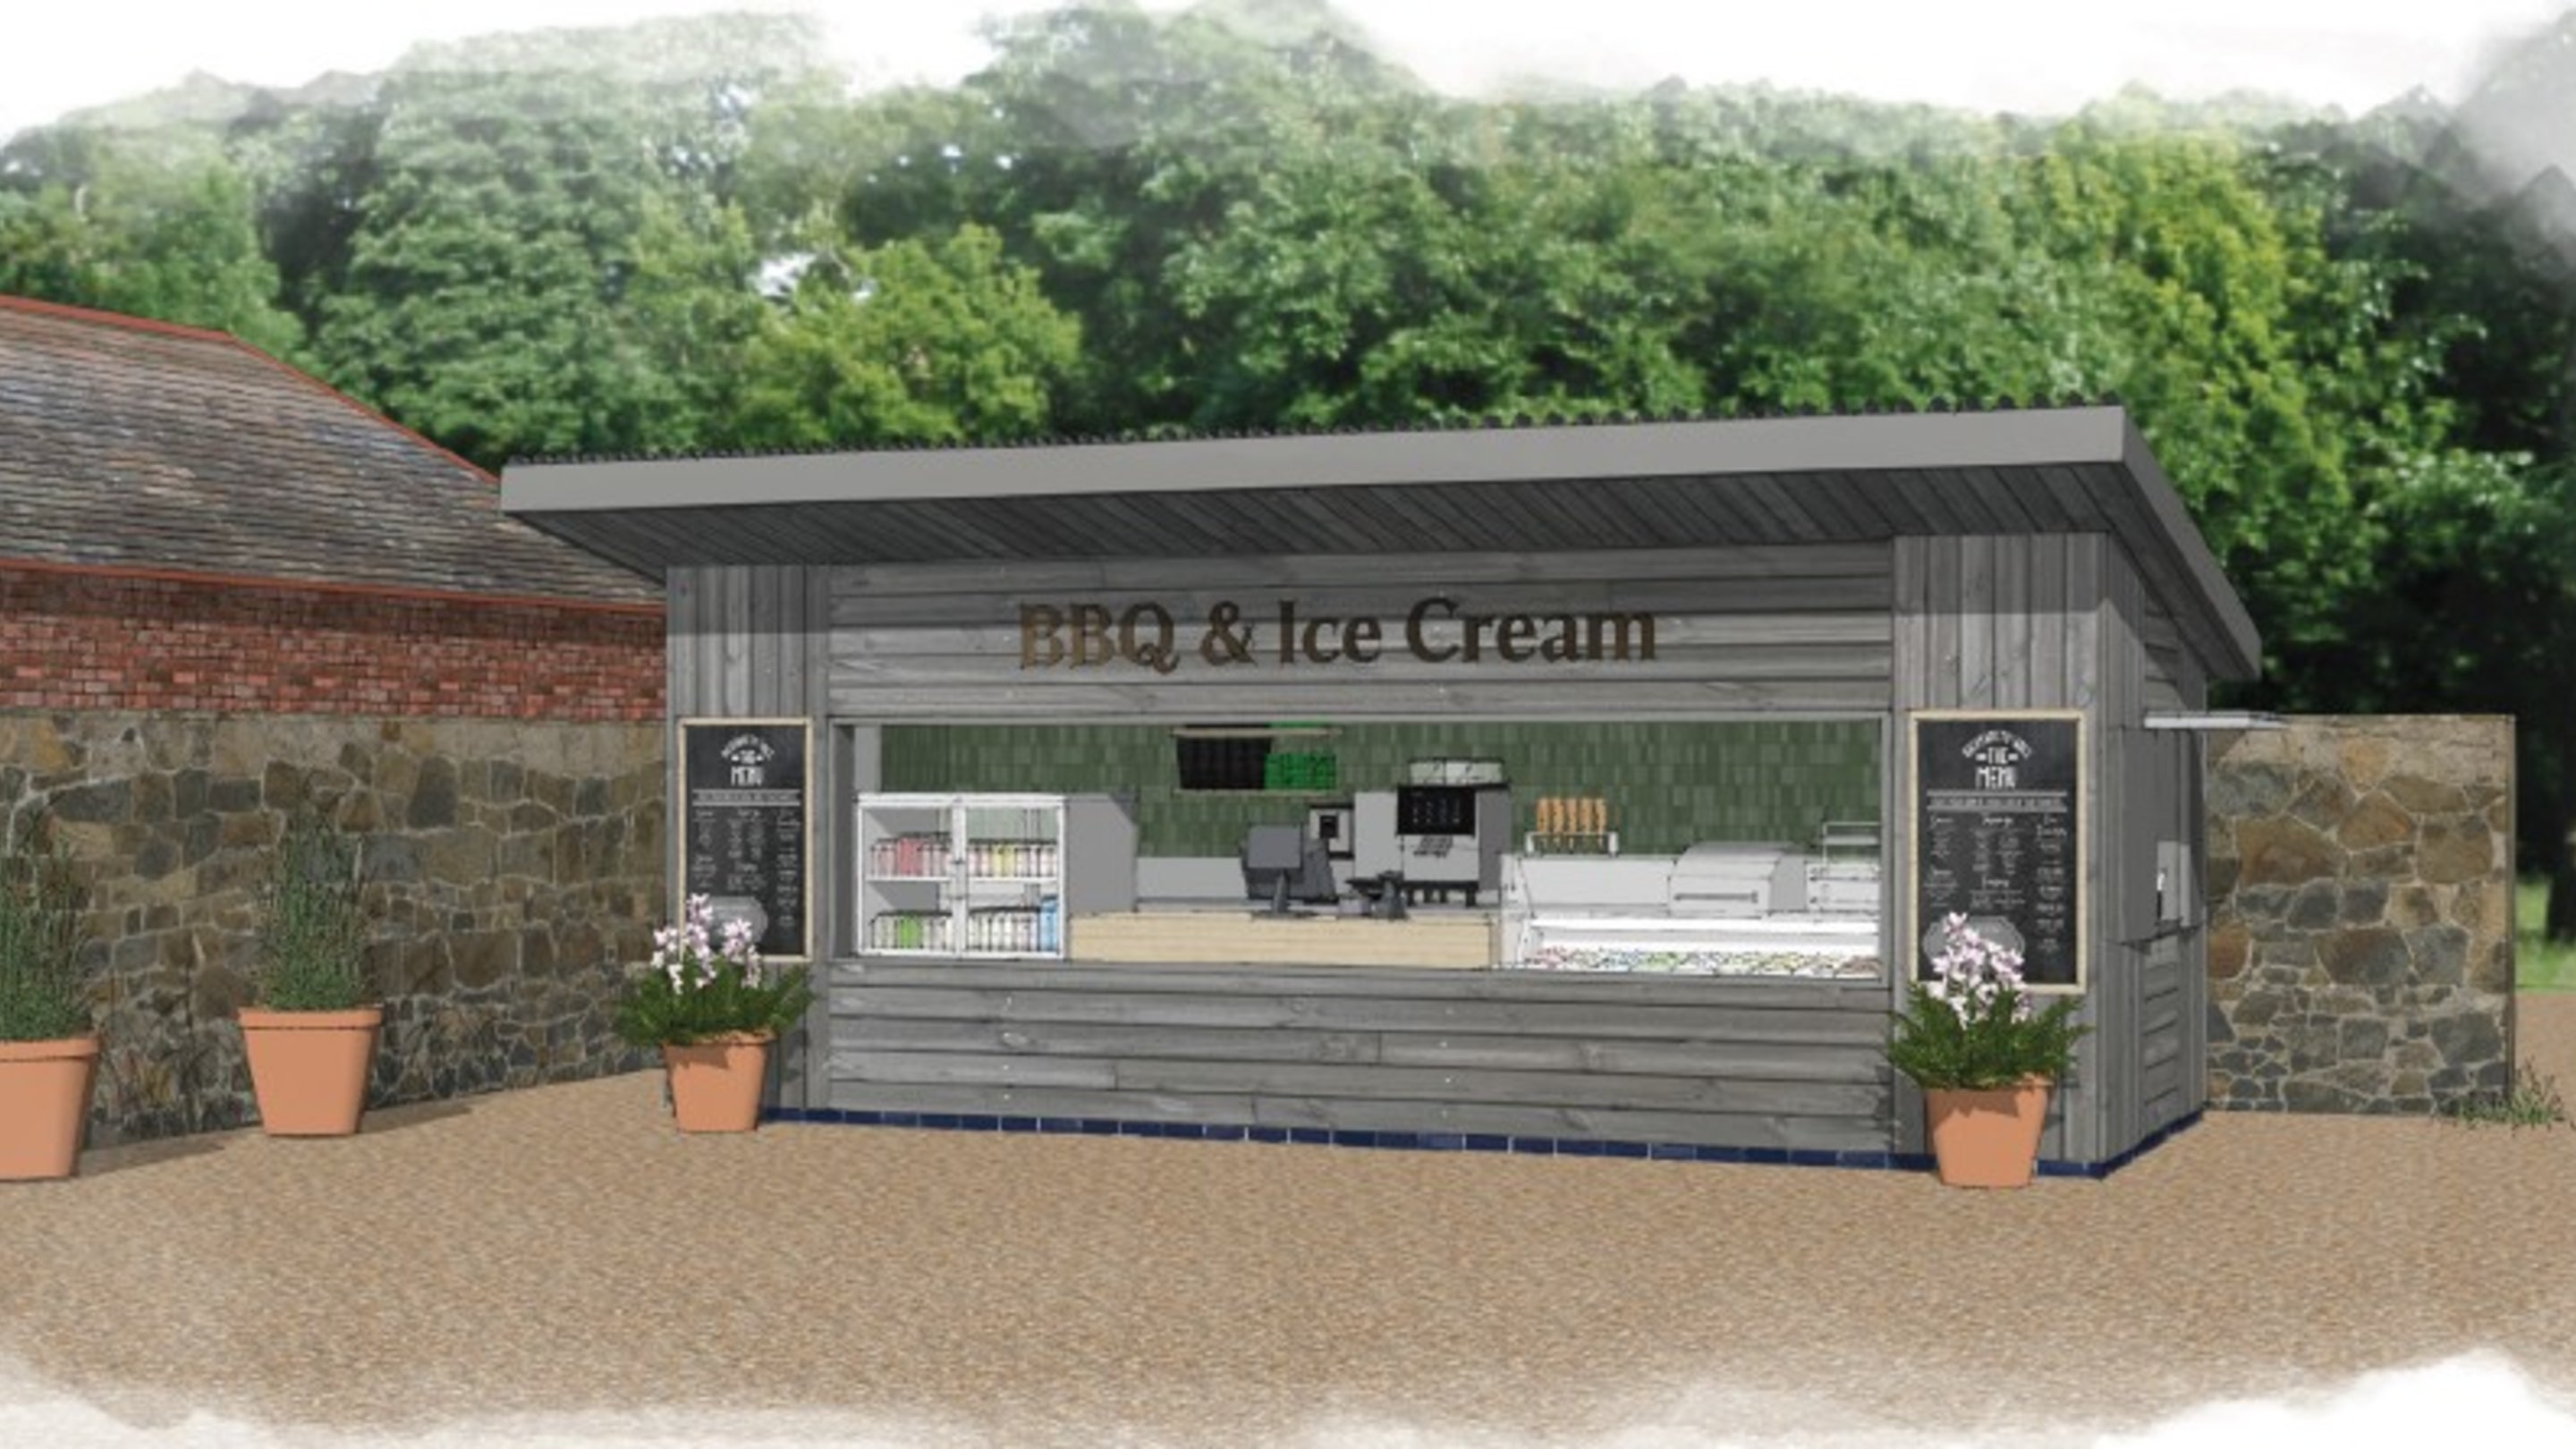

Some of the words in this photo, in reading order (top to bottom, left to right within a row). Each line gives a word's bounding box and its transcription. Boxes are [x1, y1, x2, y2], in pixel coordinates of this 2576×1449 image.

[1020, 601, 1180, 674] BBQ
[1200, 600, 1258, 667] &
[1277, 599, 1382, 664] Ice
[1405, 597, 1657, 664] Cream
